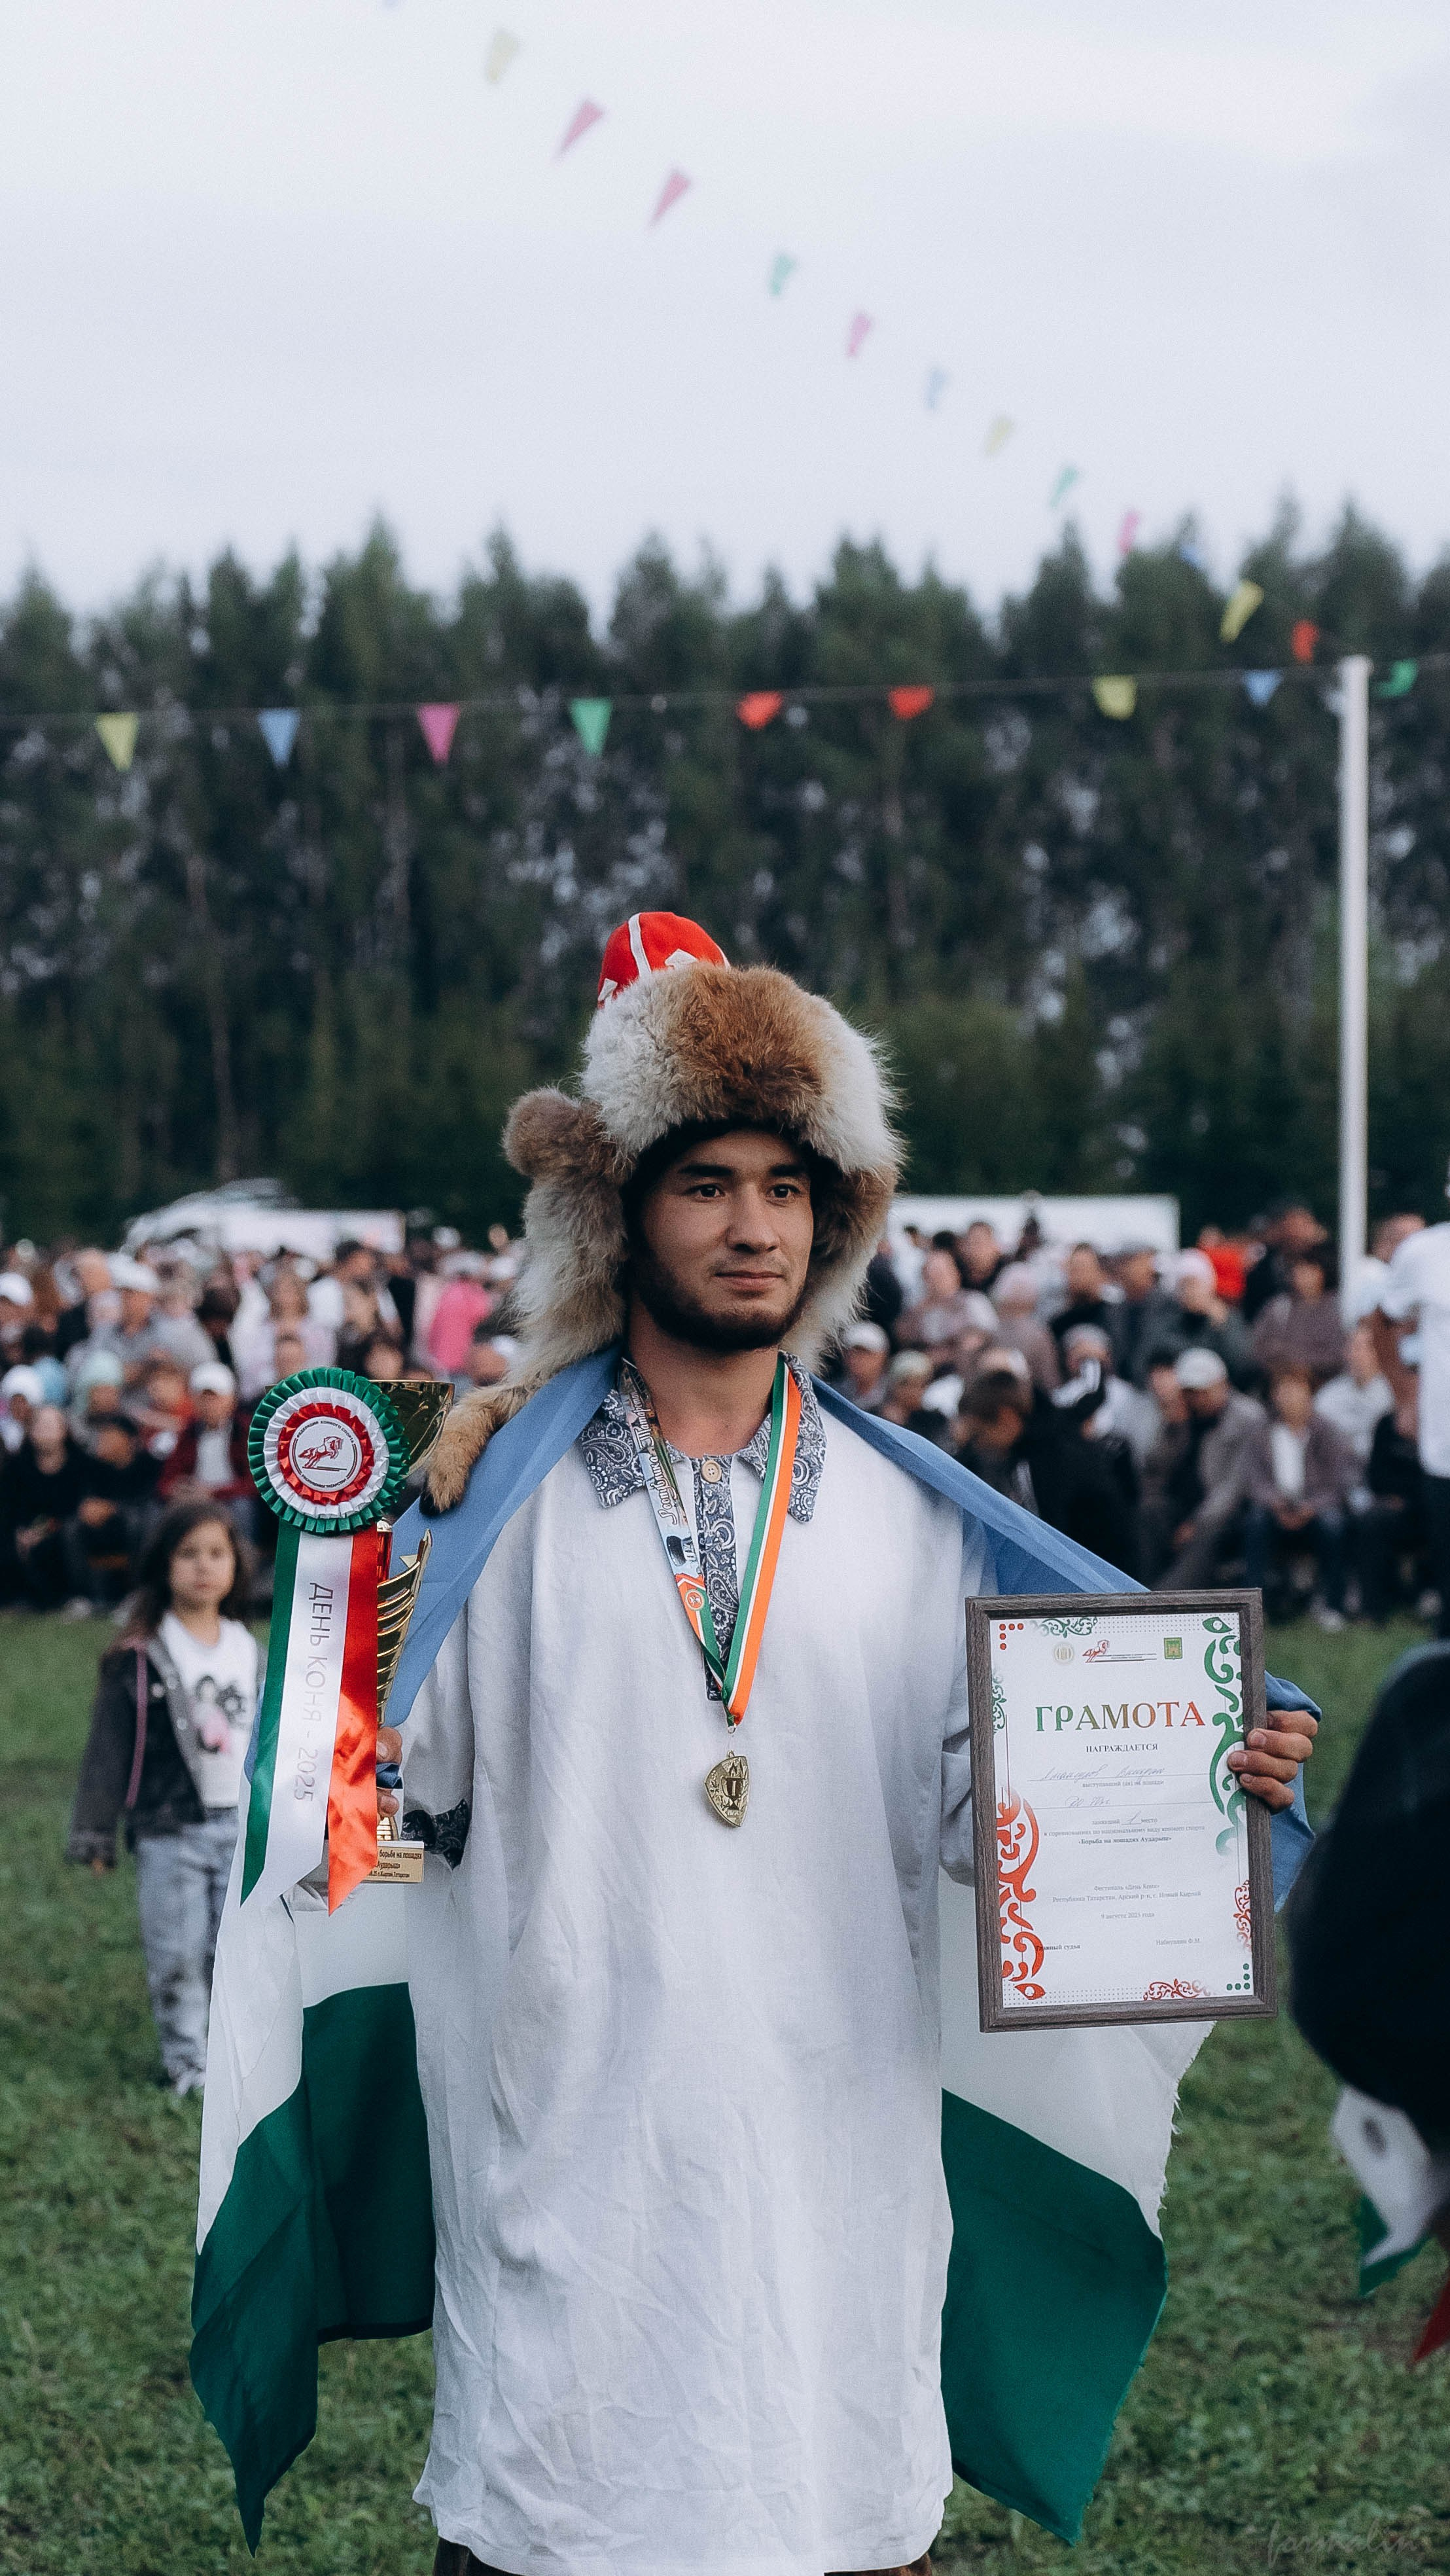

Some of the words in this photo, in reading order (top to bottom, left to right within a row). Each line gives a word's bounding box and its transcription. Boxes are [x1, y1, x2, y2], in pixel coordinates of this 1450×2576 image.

[308, 1583, 334, 1647] ДЕНЬ
[303, 1656, 328, 1723] КОНЯ
[1035, 1701, 1205, 1732] ГРАМОТА
[294, 1747, 319, 1802] 2025
[1086, 1743, 1158, 1753] НАГРАЖДАЕТСЯ
